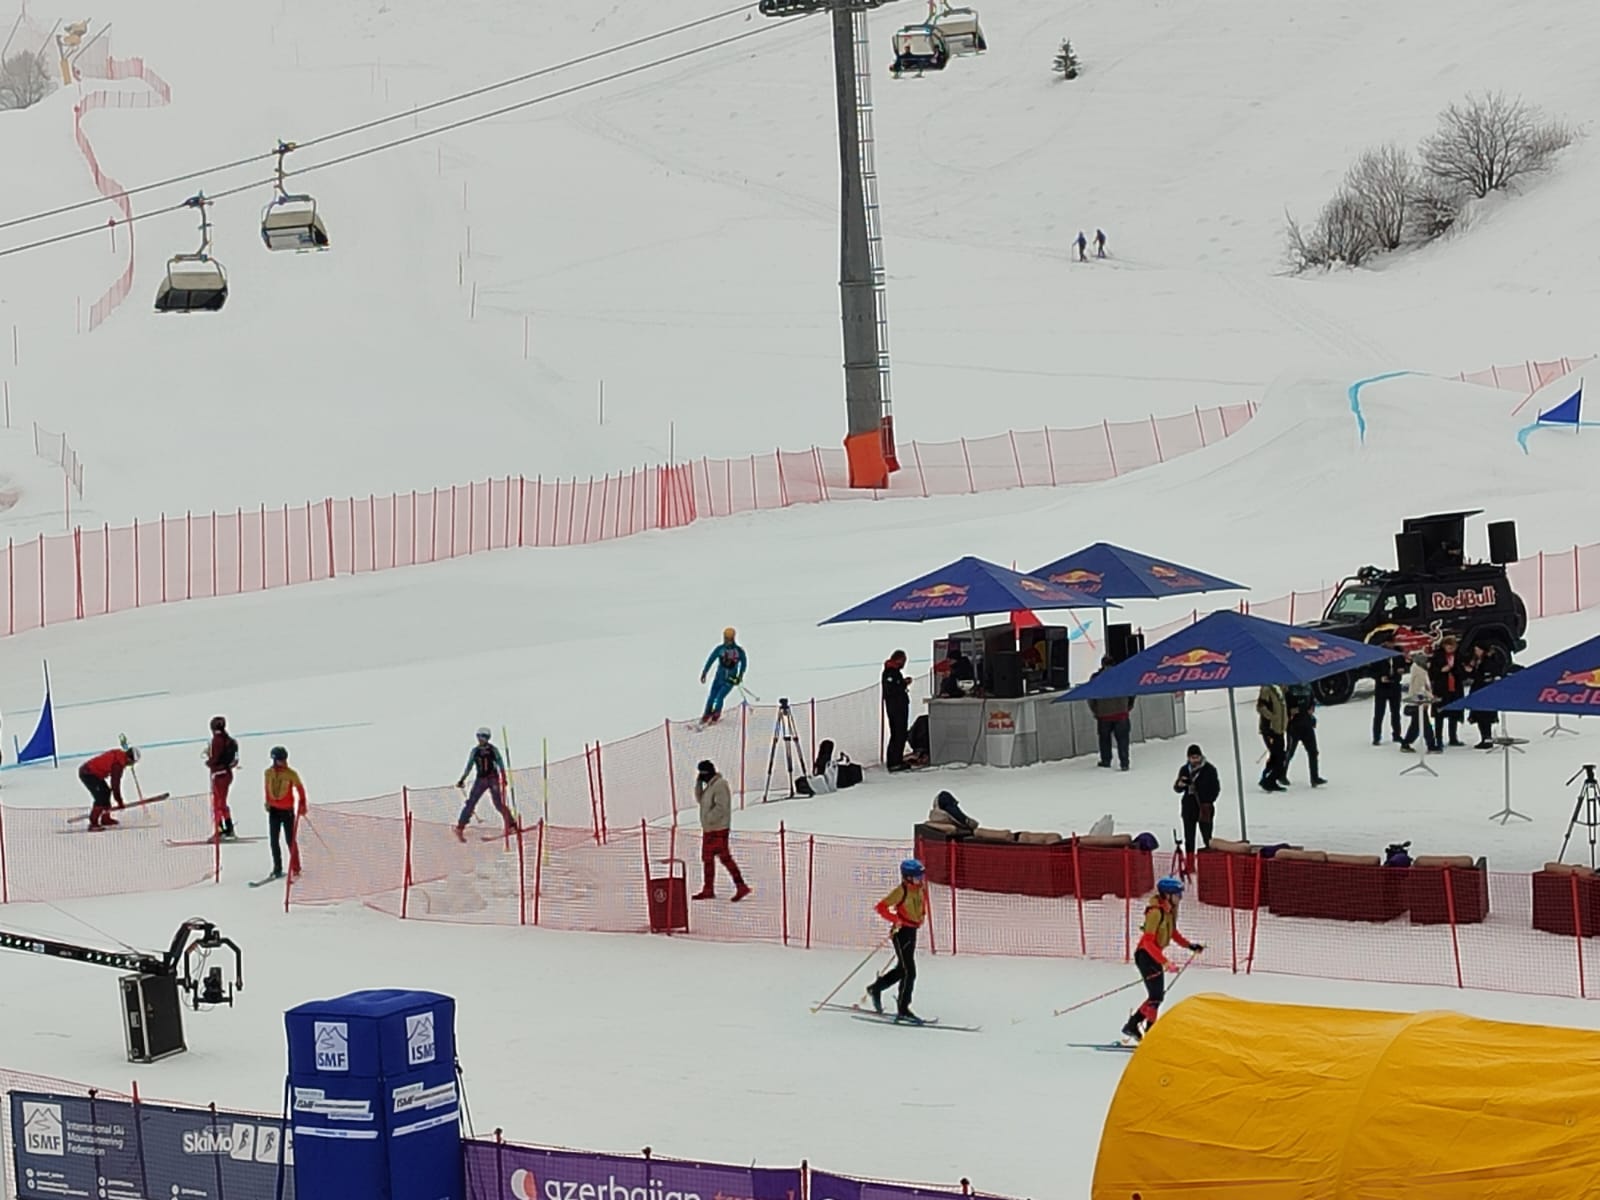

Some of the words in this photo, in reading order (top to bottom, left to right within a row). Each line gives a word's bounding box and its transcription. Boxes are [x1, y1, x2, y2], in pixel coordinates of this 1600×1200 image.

[891, 598, 929, 611] Red
[927, 596, 968, 607] Bull
[1432, 589, 1465, 611] Red
[1464, 586, 1496, 608] Bull
[1139, 668, 1186, 686] Red
[1184, 665, 1231, 680] Bull
[1538, 688, 1590, 704] Red
[317, 1052, 345, 1068] SMF
[28, 1132, 61, 1150] ISMF
[183, 1129, 233, 1153] SkiMo
